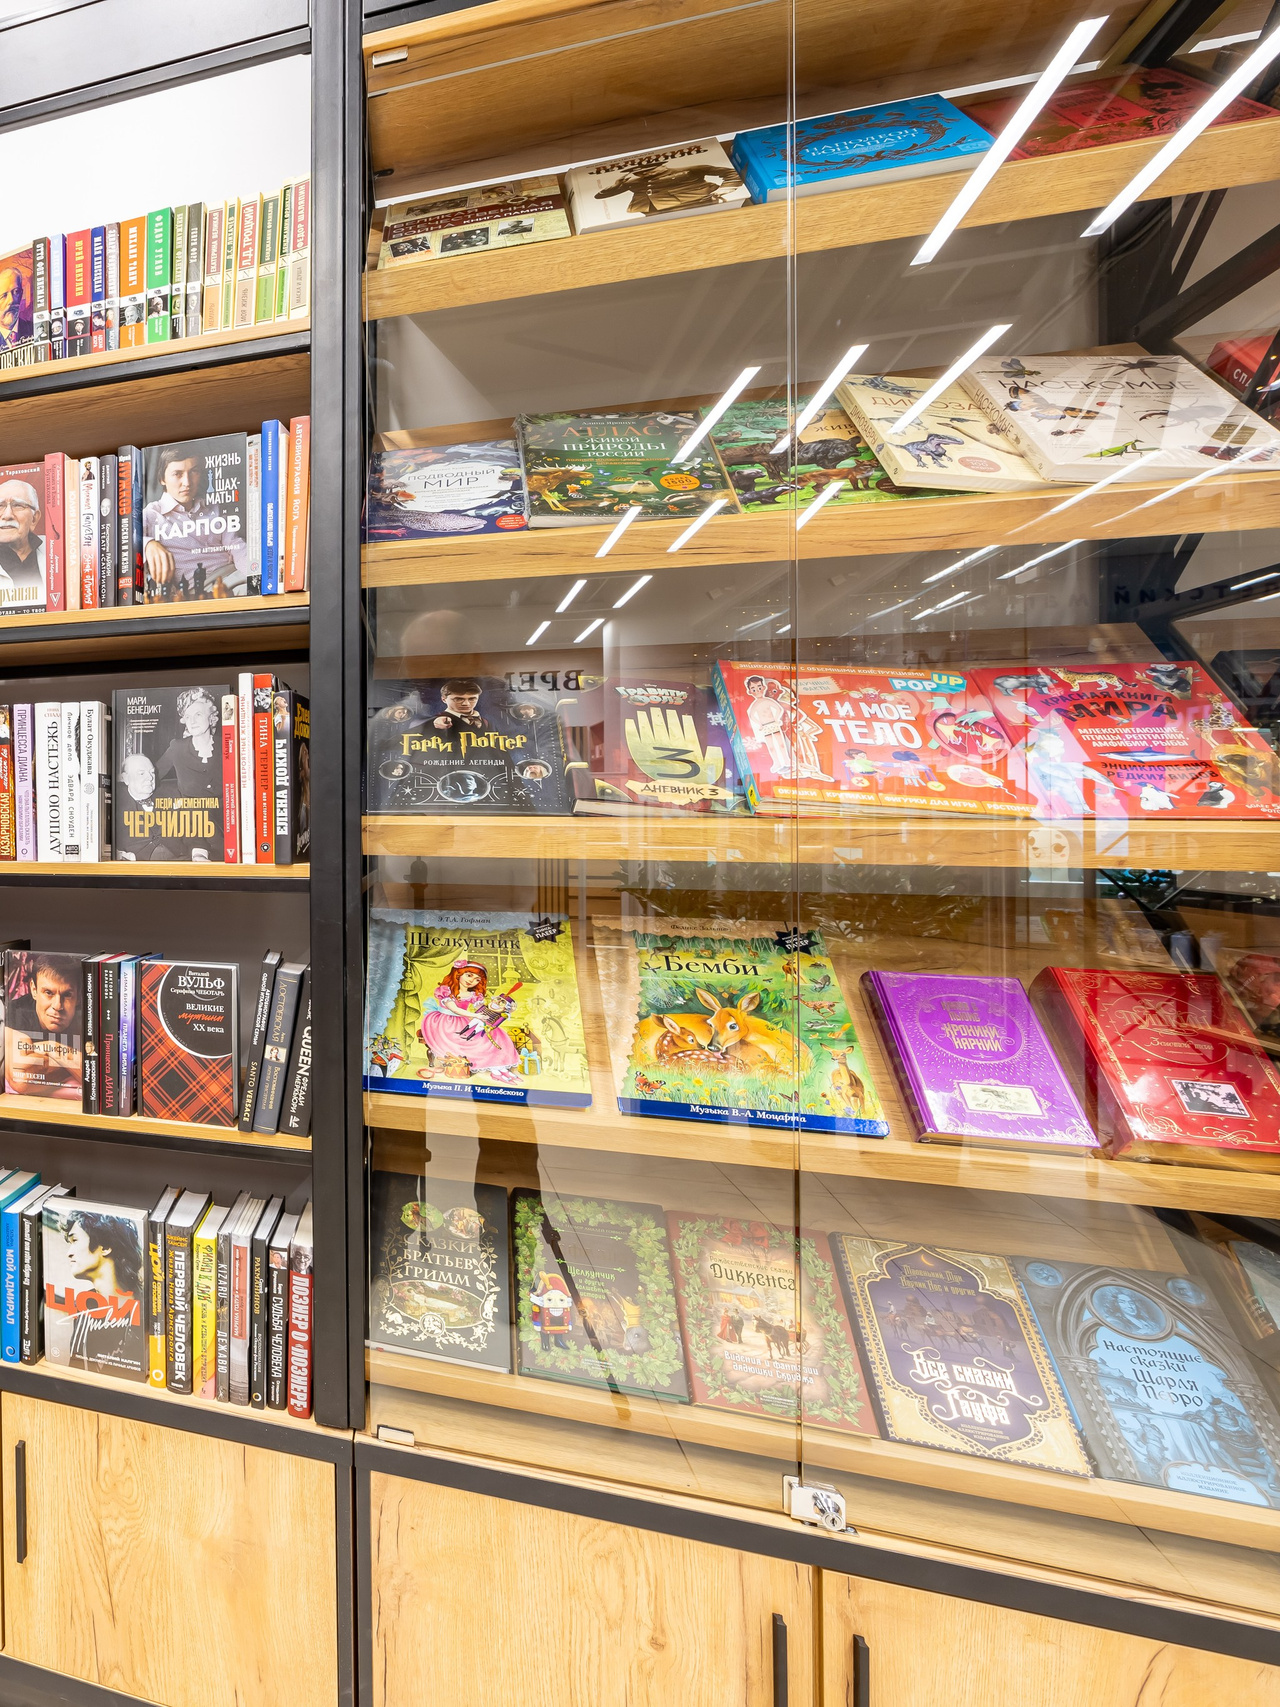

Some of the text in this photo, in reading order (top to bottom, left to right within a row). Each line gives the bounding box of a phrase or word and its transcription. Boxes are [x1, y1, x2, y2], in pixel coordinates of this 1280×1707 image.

[296, 185, 306, 248] ФЕДОР ШАЛЯПИН
[463, 205, 554, 224] КНИГА ПАМЯТИ
[243, 205, 254, 246] ТРОЦКИЙ
[128, 227, 137, 286] МИХАИЛ ТАНИЧ
[210, 237, 219, 272] ЕКАТЕРИНА
[75, 240, 83, 296] ЮРИЙ НИКУЛИН
[999, 379, 1200, 391] НАСЕКОМЫЕ
[973, 388, 1014, 436] НАСЕКОМЫЕ
[562, 424, 662, 438] АТЛАС
[850, 405, 878, 445] ДИНОЗАВРЫ
[562, 442, 667, 452] ПРИРОДЫ
[585, 436, 640, 444] ЖИВОЙ
[205, 453, 241, 468] ЖИЗНЬ
[293, 424, 302, 495] АВТОБИОГРАФИЯ
[587, 450, 645, 458] РОССИИ
[215, 468, 222, 478] И
[409, 468, 495, 481] ПОДВОДНЫЙ
[215, 477, 240, 491] ШАХ-
[423, 476, 479, 490] МИР
[206, 491, 235, 505] МАТЫ
[121, 518, 129, 544] МОСКВА
[154, 515, 241, 541] КАРПОВ
[202, 544, 240, 553] АВТОБИОГРАФИЯ
[857, 668, 926, 677] КОНСТРУКЦИЯМИ
[932, 674, 964, 686] UP
[615, 686, 687, 697] ГРАВИТИ
[892, 679, 937, 691] POP
[127, 696, 147, 705] МАРИ
[1040, 690, 1173, 707] КРАСНАЯ КНИГА
[127, 705, 162, 715] БЕНЕДИКТ
[812, 700, 917, 721] Я И МОЕ
[1054, 700, 1178, 722] МИРА
[259, 718, 268, 748] ТИНА
[823, 719, 923, 749] ТЕЛО
[1077, 727, 1184, 735] МЛЕКОПИТАЮЩИЕ,
[17, 709, 28, 782] ПРИНЦЕССА ДИАНА
[401, 731, 528, 759] Гарри Поттер
[468, 759, 505, 767] ЛЕГЕНДЫ
[1100, 761, 1213, 771] ЭНЦИКЛОПЕДИЯ
[1107, 770, 1219, 781] РЕДКИХ ВИДОВ
[47, 721, 62, 854] ДУШОЮ НАСТЕЖЬ
[641, 784, 704, 795] ДНЕВНИК
[155, 797, 172, 809] ЛЕДИ
[884, 796, 978, 809] ФИГУРКИ ДЛЯ ИГРЫ
[276, 789, 289, 836] ЕЛЕНА
[123, 811, 215, 838] ЧЕРЧИЛЛЬ
[409, 931, 521, 951] Щелкунчик
[664, 955, 762, 976] Бемби
[178, 975, 225, 989] ВУЛЬФ
[186, 1003, 224, 1012] ВЕЛИКИЕ
[941, 1022, 1000, 1038] ХРОНИКИ
[17, 1041, 78, 1055] Ефим Шифрин
[298, 1026, 312, 1076] QUEEN
[953, 1038, 1002, 1052] НАРНИИ
[243, 1061, 257, 1122] SANTO VERSACE
[422, 1082, 525, 1097] Музыка Чайковского
[690, 1104, 806, 1123] Музыка В.-А. Моцарта
[402, 1234, 474, 1254] СКАЗКИ
[402, 1249, 473, 1270] БРАТЬЕВ
[217, 1263, 228, 1299] KIZARU
[404, 1264, 471, 1287] ГРИММ
[567, 1266, 616, 1282] Щелкунчик
[709, 1262, 797, 1291] Диккенса
[5, 1249, 16, 1325] МОЙ АДМИРАЛ
[45, 1283, 141, 1327] ЦОЙ
[175, 1251, 189, 1382] ПЕРВЫЙ ЧЕЛОВЕК
[272, 1296, 283, 1378] СУДЬБА ЧЕЛОВЕКА
[290, 1275, 309, 1412] ПОЗНЕР «ПОЗНЕРЕ»
[217, 1330, 227, 1374] ДЕЖАВЮ
[724, 1350, 761, 1366] Видения
[1103, 1339, 1203, 1364] Настоящие
[1129, 1355, 1188, 1374] сказки
[1132, 1367, 1199, 1391] Шарля
[1141, 1385, 1203, 1407] Перро
